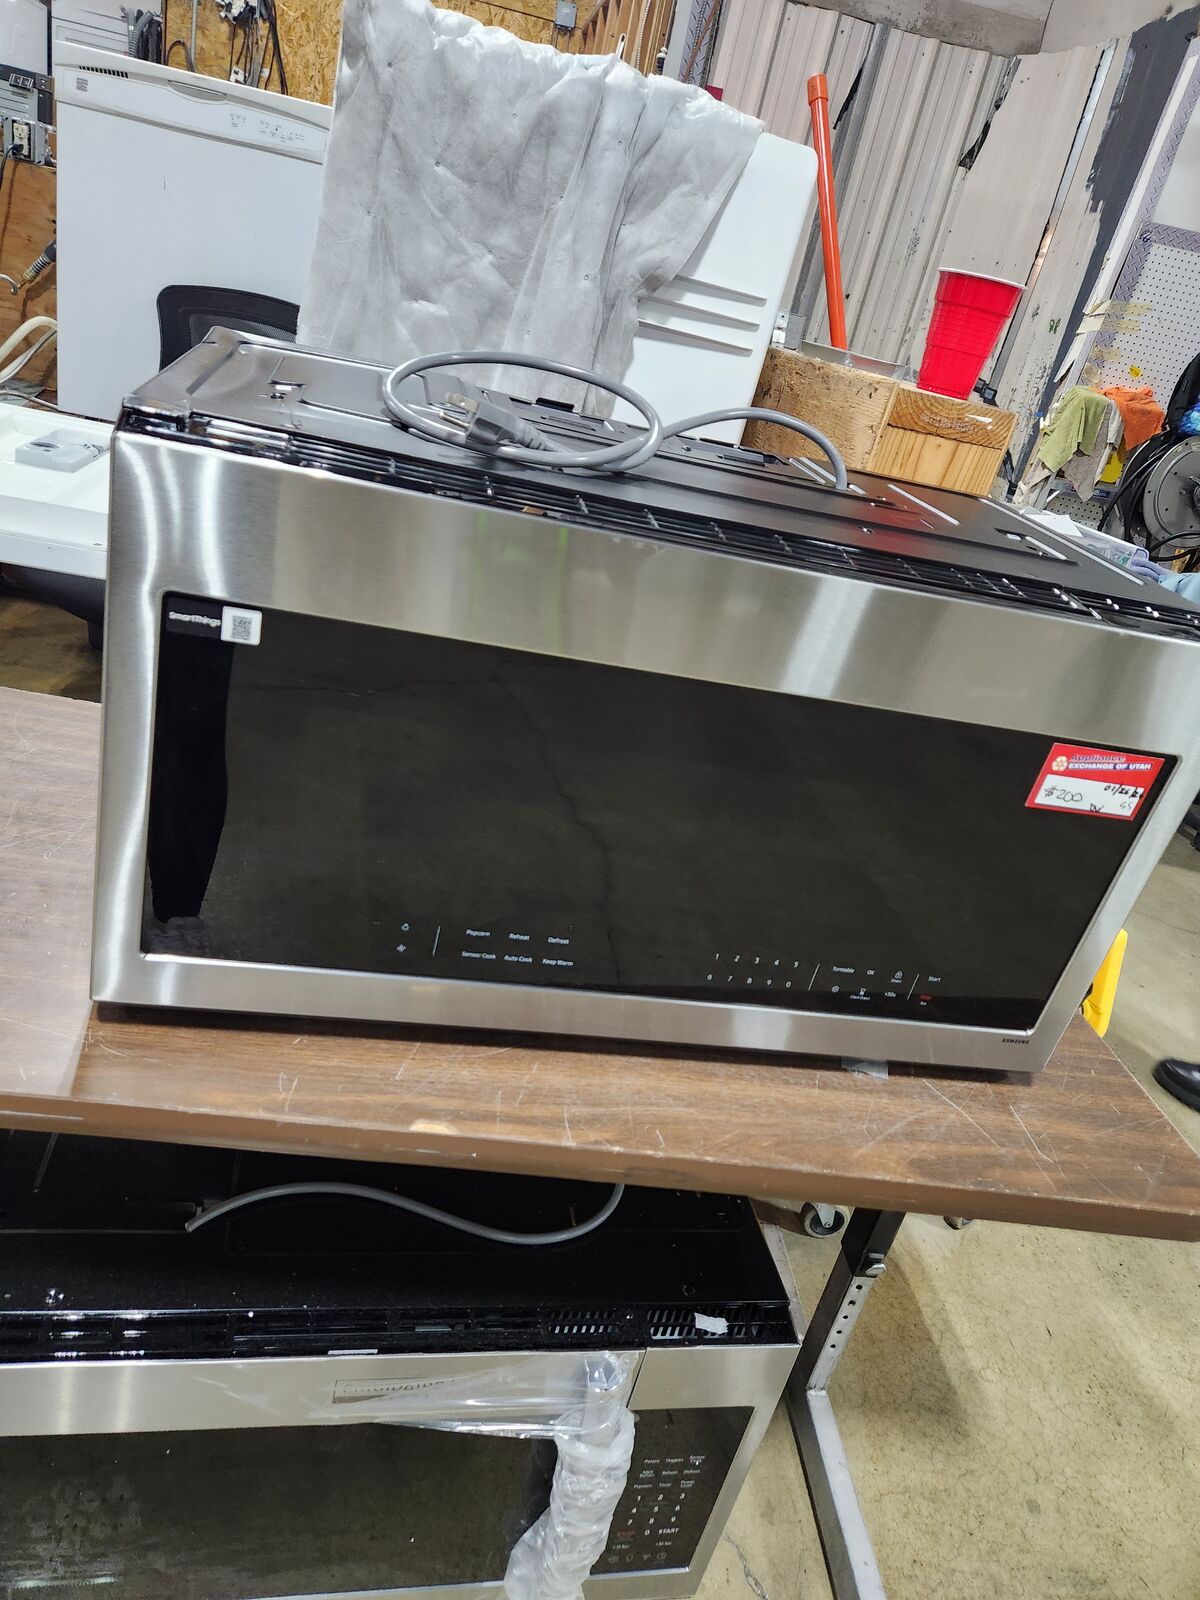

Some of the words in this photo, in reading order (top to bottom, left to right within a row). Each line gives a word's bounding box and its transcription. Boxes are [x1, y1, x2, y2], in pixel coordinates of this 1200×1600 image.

[1068, 762, 1114, 770] EXCHANGE
[466, 929, 491, 937] Popcorn
[509, 933, 530, 941] Reheat
[548, 937, 570, 945] Defrost
[462, 951, 481, 959] Sensor
